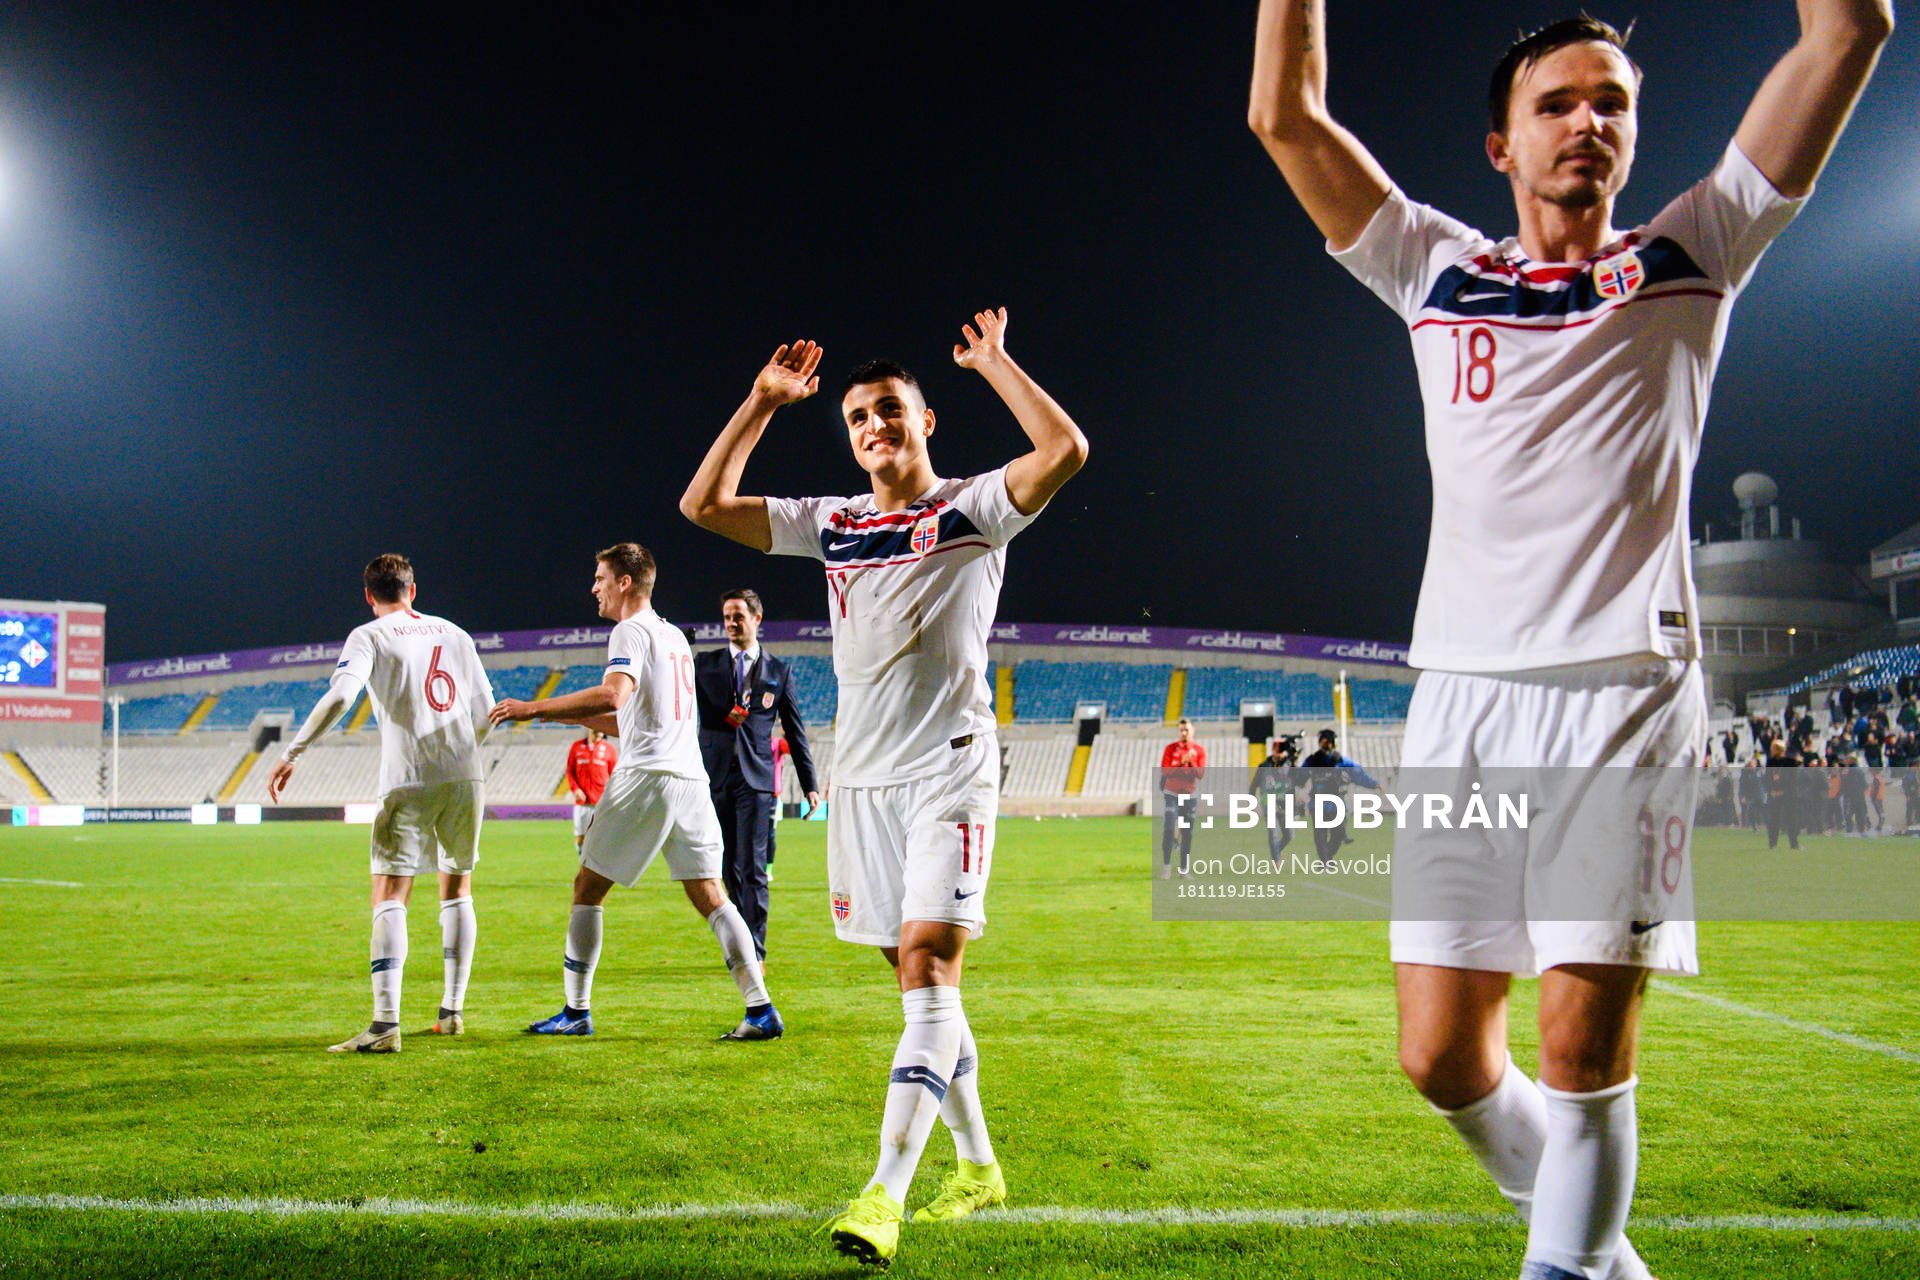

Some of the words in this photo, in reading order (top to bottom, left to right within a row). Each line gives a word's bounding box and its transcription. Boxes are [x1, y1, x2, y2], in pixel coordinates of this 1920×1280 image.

[1451, 327, 1496, 405] 18
[12, 703, 72, 719] Vodafone
[424, 645, 456, 713] 6
[669, 651, 694, 721] 19
[956, 822, 985, 876] 11
[1637, 810, 1686, 895] 18
